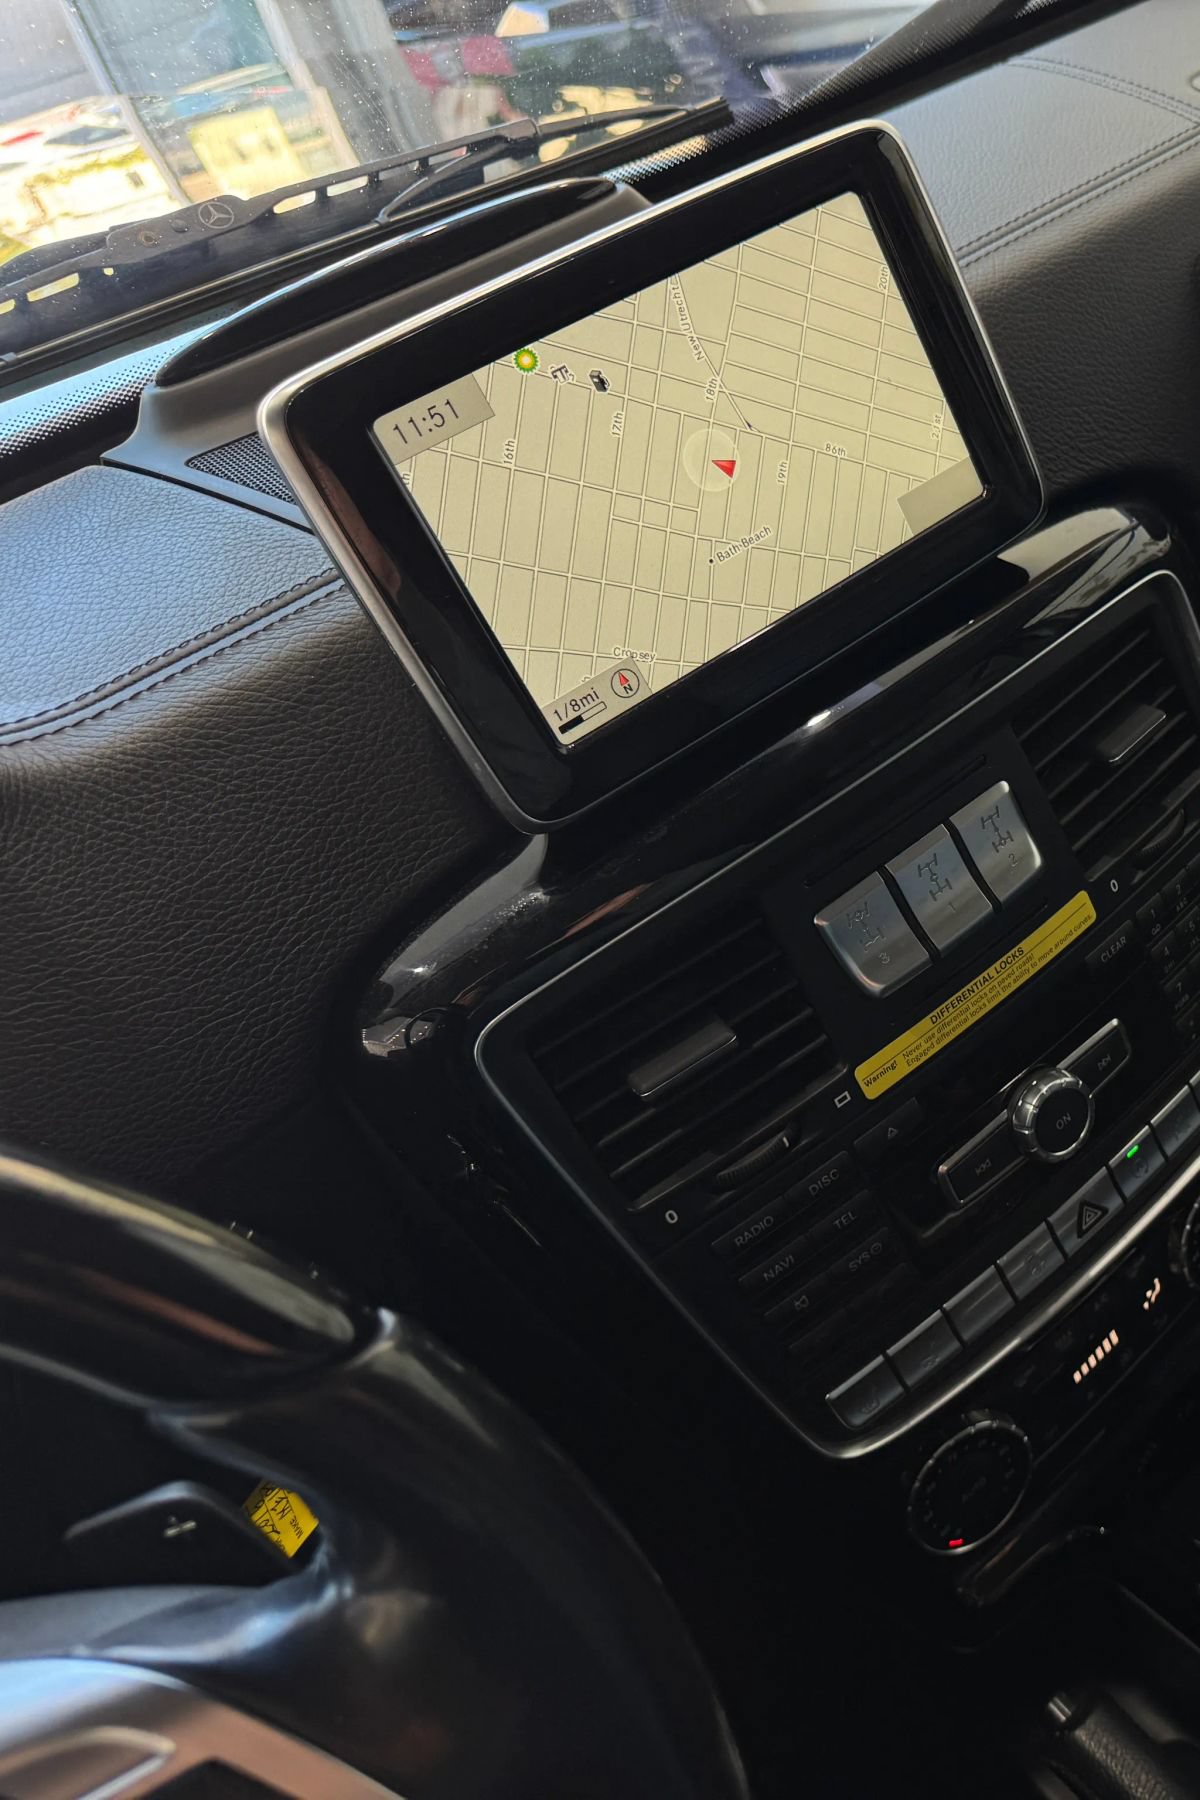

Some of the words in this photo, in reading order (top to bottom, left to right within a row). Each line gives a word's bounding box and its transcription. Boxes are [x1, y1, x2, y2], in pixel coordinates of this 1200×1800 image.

[879, 266, 888, 290] 20th
[672, 286, 692, 333] Utrecht
[687, 335, 703, 361] New
[706, 378, 717, 402] 18th
[393, 399, 459, 444] 11:51
[612, 412, 624, 437] 17th
[504, 440, 516, 465] 16th
[825, 443, 846, 457] 86th
[777, 462, 788, 486] 19th
[716, 541, 741, 562] Bath
[741, 526, 772, 550] Beach
[614, 647, 656, 662] Cropsey
[622, 684, 633, 694] N
[554, 688, 600, 722] 1/8mi
[1100, 936, 1128, 963] CLEAR
[930, 973, 995, 1025] DIFFERENTIAL
[994, 946, 1024, 974] LOCKS
[906, 1042, 935, 1068] Engaged
[935, 1016, 970, 1048] differential
[970, 1002, 987, 1019] locks
[988, 990, 1002, 1004] limit
[1002, 982, 1012, 993] the
[1012, 968, 1030, 986] ability
[1038, 946, 1054, 963] move
[1054, 930, 1074, 950] around
[864, 1060, 898, 1088] Warning!
[902, 1042, 923, 1060] Never
[924, 1033, 936, 1046] use
[936, 1006, 970, 1034] differential
[970, 992, 988, 1010] locks
[988, 984, 998, 994] on
[998, 970, 1016, 988] paved
[1016, 953, 1034, 972] roads!
[1056, 1113, 1072, 1130] ON
[808, 1168, 840, 1196] DISC
[735, 1216, 774, 1247] RADIO
[833, 1210, 857, 1230] TEL
[763, 1254, 795, 1281] NAVI
[848, 1251, 870, 1272] SYS
